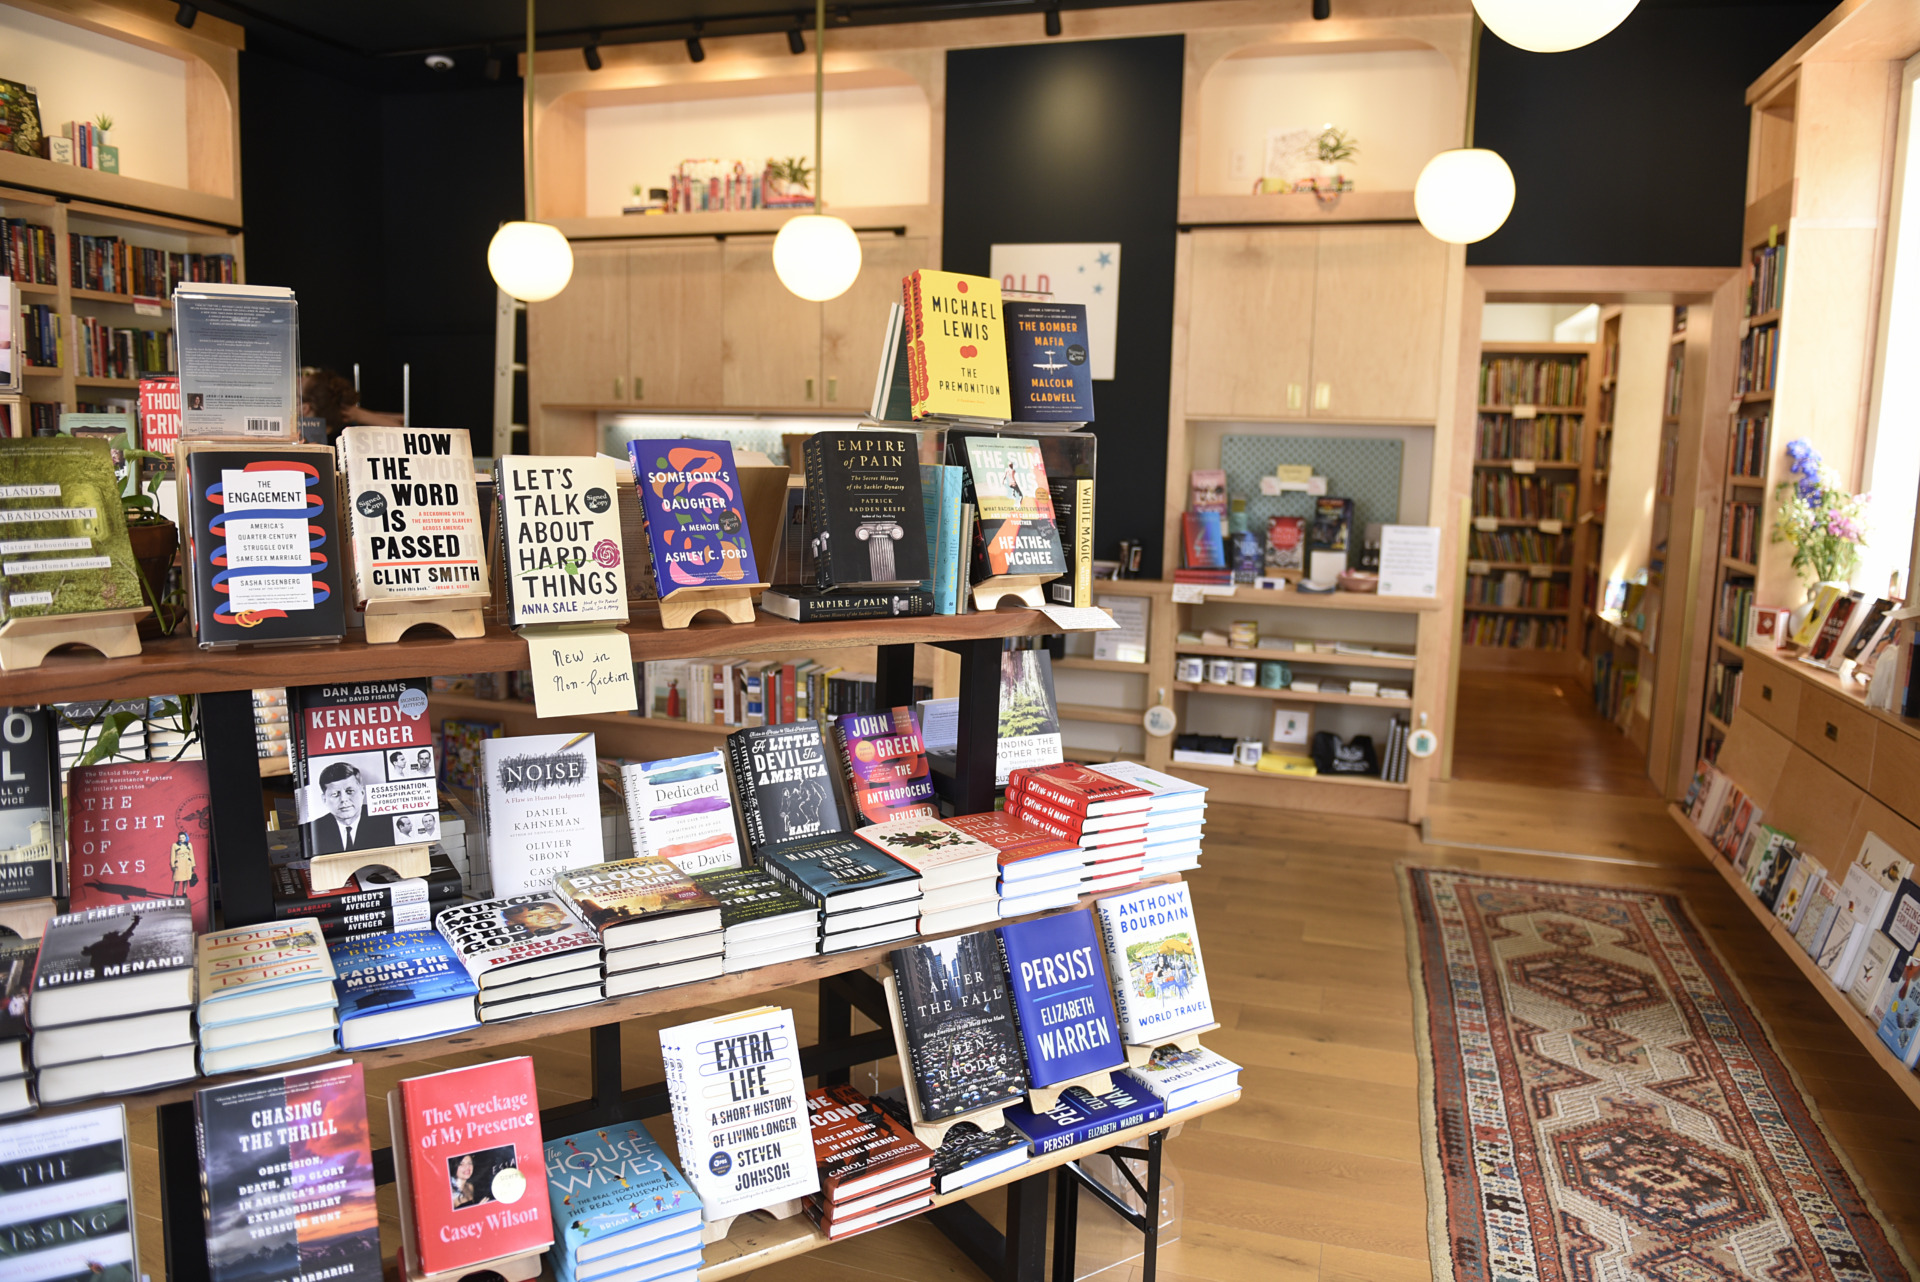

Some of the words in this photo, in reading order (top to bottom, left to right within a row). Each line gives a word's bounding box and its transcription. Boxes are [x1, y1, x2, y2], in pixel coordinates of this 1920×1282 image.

[932, 295, 996, 320] MICHAEL
[943, 319, 989, 341] LEWIS
[1019, 321, 1036, 331] THE
[1040, 321, 1078, 332] BOMBER
[1034, 336, 1064, 347] MAFIA
[961, 367, 977, 378] THE
[1031, 378, 1073, 388] MALCOLM
[939, 380, 1000, 395] PREMONITION
[1030, 393, 1076, 402] GLADWELL
[403, 433, 451, 455] HOW
[838, 440, 906, 452] EMPIRE
[367, 457, 411, 480] THE
[843, 456, 855, 468] of
[860, 455, 903, 467] PAIN
[972, 450, 1004, 469] THE
[1007, 451, 1043, 471] SUM
[513, 468, 573, 491] LET'S
[648, 471, 730, 483] SOMEBODY'S
[228, 491, 301, 503] ENGAGEMENT
[391, 483, 458, 506] WORD
[514, 493, 580, 516] TALK
[663, 498, 726, 510] DAUGHTER
[1082, 487, 1091, 524] WHITE
[382, 508, 406, 532] IS
[519, 520, 594, 544] ABOUT
[998, 535, 1051, 549] HEATHER
[370, 534, 460, 560] PASSED
[1081, 526, 1090, 563] MAGIC
[519, 546, 586, 571] HARD
[1004, 551, 1053, 565] MCGHEE
[373, 568, 421, 585] CLINT
[428, 566, 480, 582] SMITH
[522, 571, 617, 598] THINGS
[522, 603, 549, 615] ANNA
[553, 601, 577, 613] SALE
[593, 653, 610, 662] in
[323, 687, 348, 698] DAN
[354, 682, 406, 695] ABRAMS
[553, 669, 629, 694] Non-fiction
[402, 701, 425, 709] AUTHOR
[324, 725, 414, 750] AVENGER
[852, 715, 889, 737] JOHN
[876, 735, 920, 758] GREEN
[507, 762, 581, 783] NOISE
[758, 764, 827, 786] AMERICA
[894, 764, 912, 777] THE
[371, 782, 429, 793] ASSASSINATION,
[656, 779, 719, 802] Dedicated
[867, 782, 931, 805] ANTHROPOCENE
[84, 795, 132, 811] THE
[372, 804, 398, 813] JACK
[402, 801, 430, 810] RUBY
[526, 807, 568, 818] DANIEL
[889, 806, 933, 822] REVIEWED
[83, 815, 165, 833] LIGHT
[514, 818, 581, 831] KAHNEMAN
[83, 841, 111, 854] OF
[526, 840, 572, 851] OLIVIER
[529, 851, 570, 861] SIBONY
[785, 842, 862, 862] MADHOUSE
[83, 860, 146, 877] DAYS
[698, 850, 732, 867] Davis
[569, 864, 674, 889] BLOOD
[341, 891, 384, 904] KENNEDY'S
[345, 900, 381, 911] AVENGER
[440, 892, 553, 921] PUNCH
[721, 891, 782, 906] TREES
[1119, 891, 1184, 917] ANTHONY
[52, 914, 81, 926] THE
[88, 905, 125, 919] FREE
[131, 899, 185, 911] WORLD
[343, 910, 386, 924] KENNEDY'S
[1120, 906, 1188, 933] BOURDAIN
[348, 920, 383, 931] AVENGER
[349, 938, 424, 956] BROWN
[463, 932, 534, 955] GOD
[488, 937, 597, 966] BROOME
[508, 931, 590, 954] BRIAN
[38, 969, 95, 988] LOUIS
[104, 955, 184, 977] MENAND
[340, 962, 409, 981] FACING
[412, 954, 450, 967] THE
[346, 962, 449, 988] MOUNTAIN
[1020, 947, 1094, 992] PERSIST
[930, 971, 984, 994] AFTER
[917, 999, 952, 1017] THE
[961, 988, 1002, 1008] FALL
[1040, 996, 1095, 1026] ELIZABETH
[1139, 1010, 1171, 1027] WORLD
[1175, 1001, 1207, 1017] TRAVEL
[953, 1037, 986, 1056] BEN
[1037, 1016, 1111, 1061] WARREN
[714, 1032, 774, 1071] EXTRA
[939, 1053, 1007, 1082] RHODES
[729, 1065, 769, 1102] LIFE
[251, 1100, 322, 1128] CHASING
[422, 1108, 452, 1126] The
[454, 1093, 528, 1120] Wreckage
[711, 1113, 718, 1126] A
[720, 1105, 751, 1124] SHORT
[753, 1095, 792, 1117] HISTORY
[239, 1130, 273, 1152] THE
[277, 1118, 337, 1145] THRILL
[421, 1130, 438, 1148] of
[441, 1127, 464, 1145] My
[467, 1113, 534, 1139] Presence
[713, 1133, 725, 1148] OF
[727, 1126, 759, 1145] LIVING
[761, 1116, 797, 1137] LONGER
[814, 1134, 837, 1146] RACE
[838, 1129, 852, 1139] AND
[853, 1123, 876, 1133] GUNS
[1043, 1133, 1074, 1153] PERSIST
[1088, 1122, 1117, 1139] ELIZABETH
[1120, 1114, 1144, 1129] WARREN
[737, 1142, 781, 1167] STEVEN
[825, 1148, 865, 1163] UNEQUAL
[865, 1135, 900, 1150] AMERICA
[828, 1160, 865, 1177] CAROL
[866, 1142, 920, 1161] ANDERSON
[258, 1156, 323, 1176] OBSESSION,
[551, 1153, 662, 1194] WIVES
[735, 1162, 790, 1191] JOHNSON
[239, 1180, 280, 1196] DEATH,
[283, 1175, 305, 1186] AND
[309, 1166, 344, 1181] GLORY
[248, 1196, 341, 1224] EXTRAORDINARY
[567, 1208, 589, 1218] THE
[590, 1199, 614, 1211] REAL
[616, 1181, 679, 1204] HOUSEWIVES
[440, 1221, 485, 1242] Casey
[486, 1208, 538, 1230] Wilson
